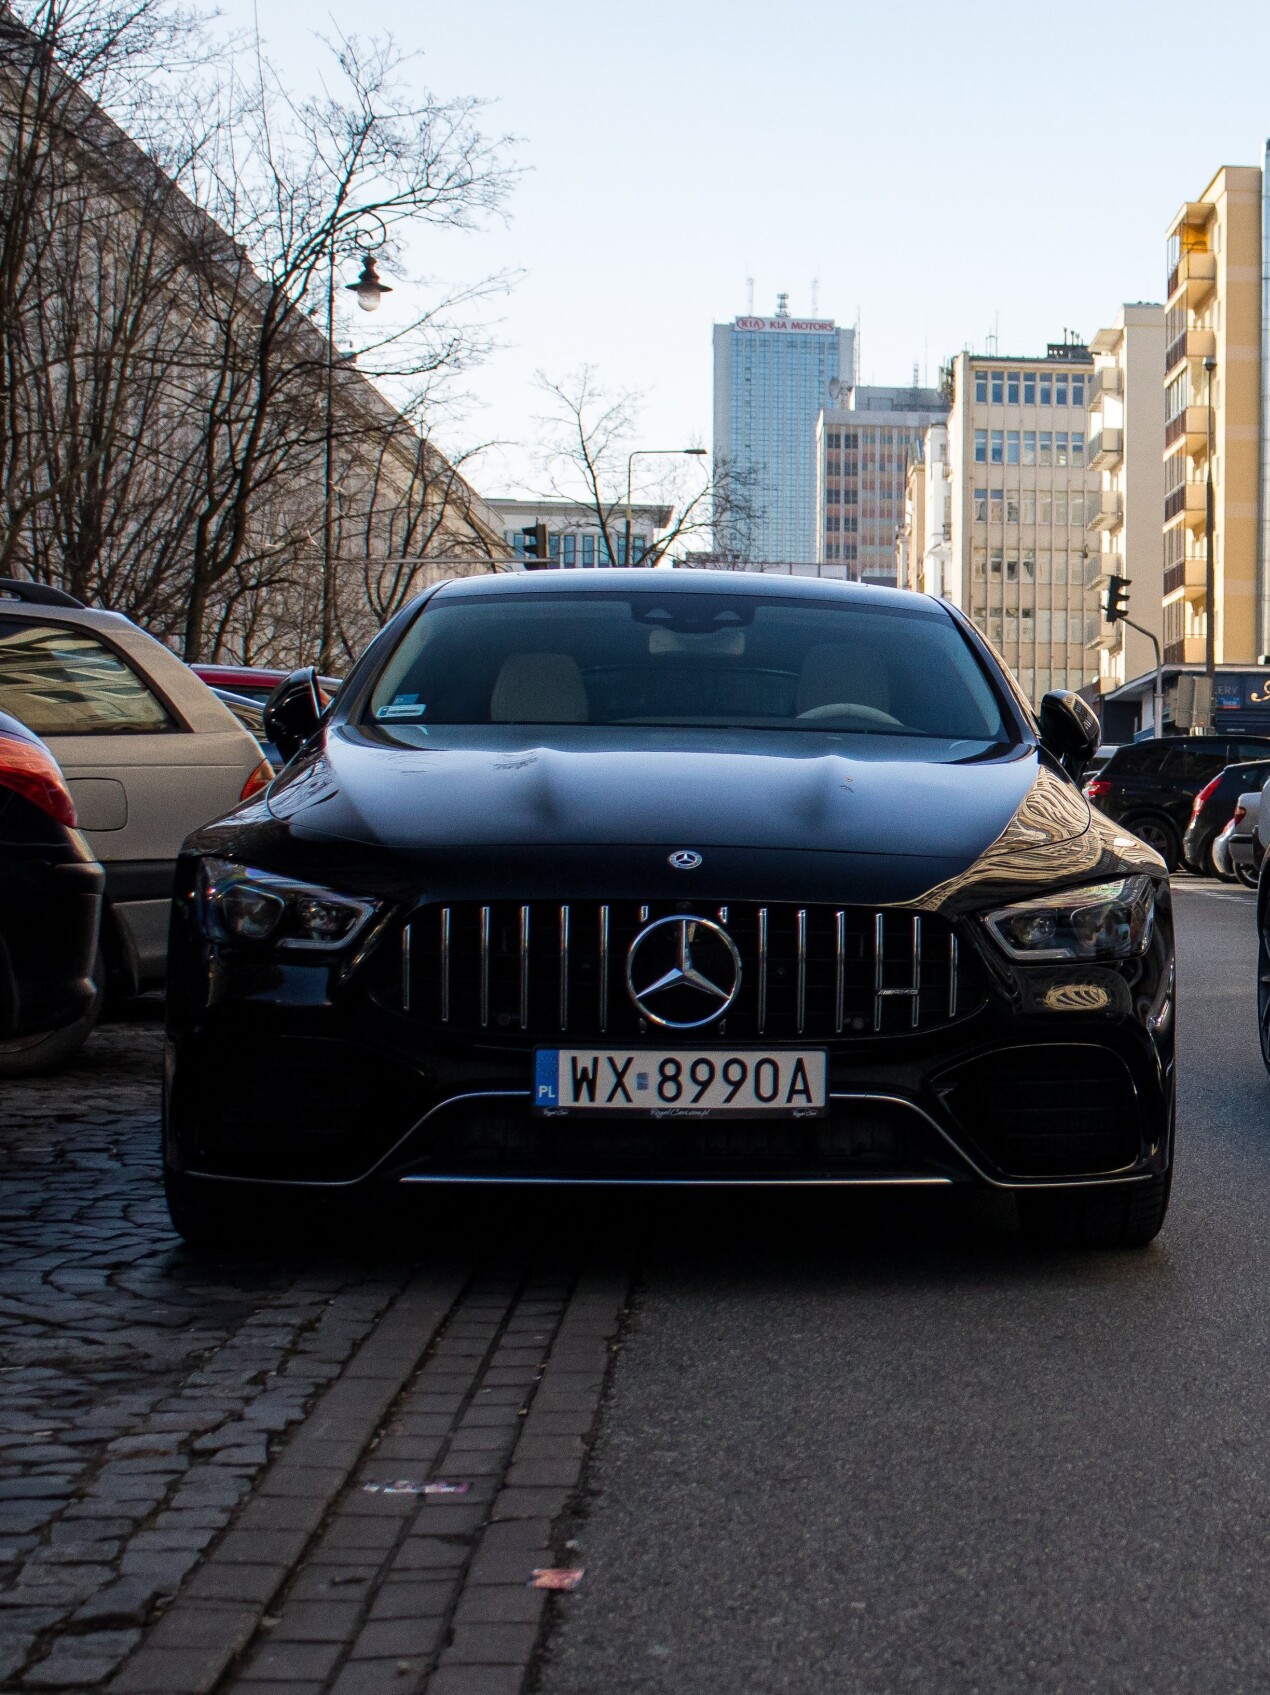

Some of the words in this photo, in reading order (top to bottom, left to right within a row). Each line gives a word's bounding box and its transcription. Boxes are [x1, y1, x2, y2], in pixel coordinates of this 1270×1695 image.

[769, 320, 787, 330] KIA
[791, 321, 834, 331] MOTORS
[539, 1085, 555, 1098] PL
[571, 1056, 635, 1104] WX
[657, 1057, 813, 1104] 8990A
